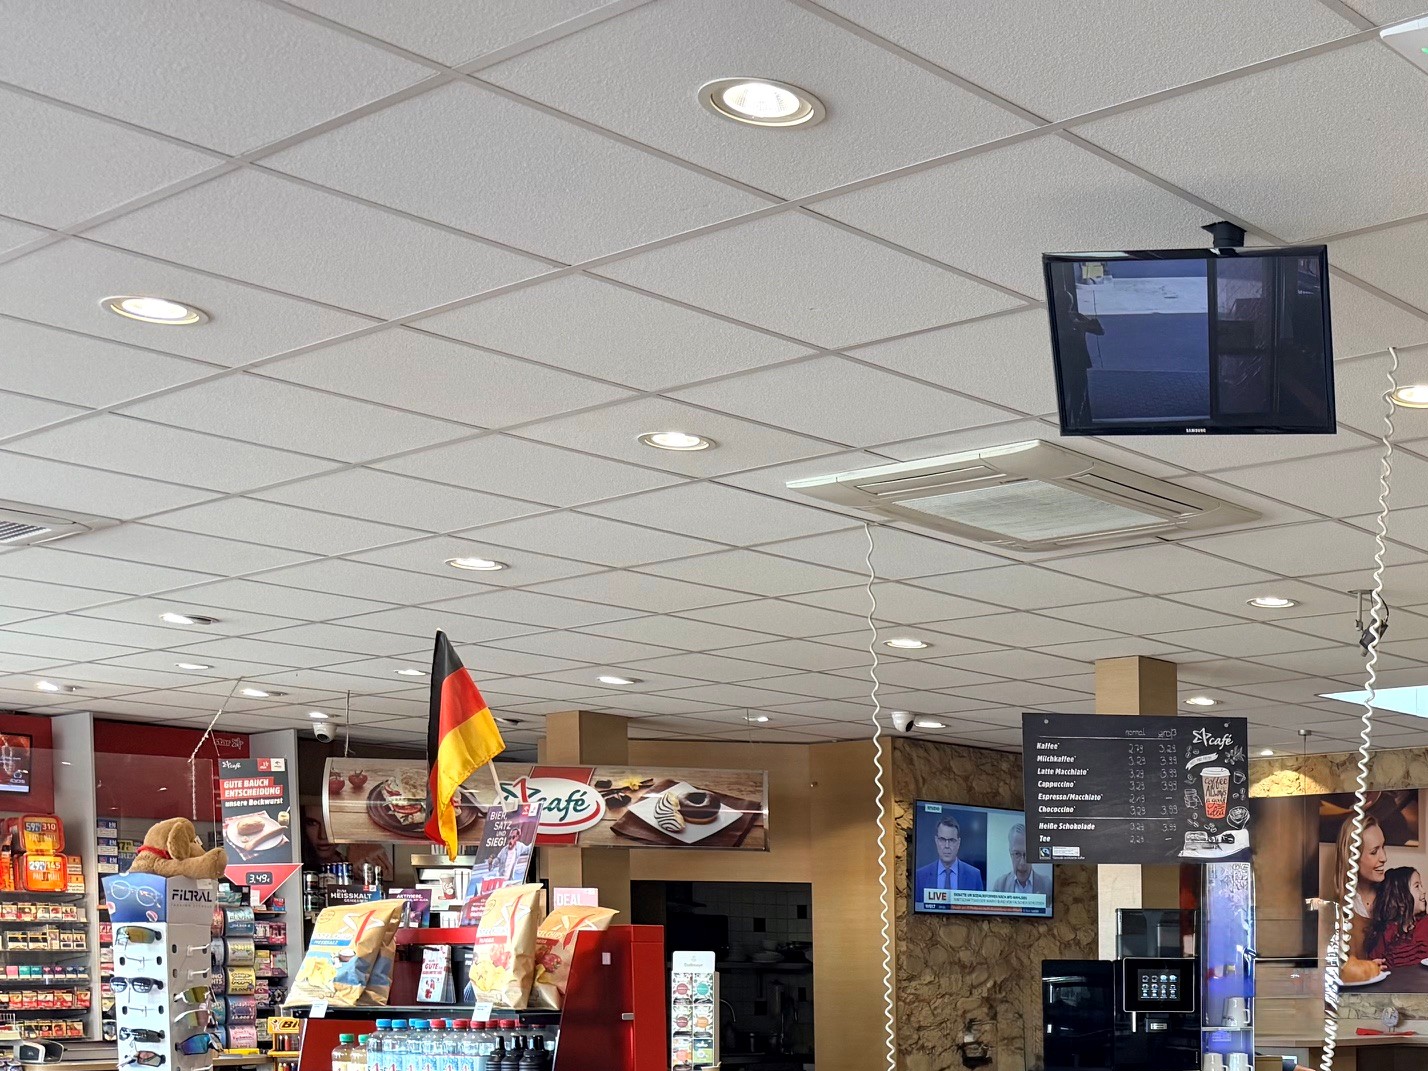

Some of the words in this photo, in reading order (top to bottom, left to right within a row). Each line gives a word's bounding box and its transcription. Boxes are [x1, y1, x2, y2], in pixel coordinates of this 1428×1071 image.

[1207, 732, 1234, 750] café
[1037, 767, 1055, 775] Latte
[223, 780, 243, 788] GUTE
[243, 778, 269, 788] BAUCH
[224, 787, 281, 798] ENTSCHEIDUNG
[224, 799, 248, 807] unsere
[248, 797, 284, 806] Bockwurst
[542, 789, 590, 822] café
[493, 821, 512, 830] SATZ
[1038, 822, 1058, 830] Heiße
[1058, 822, 1096, 831] Schokolade
[1039, 835, 1051, 843] Tee
[928, 891, 947, 901] LIVE
